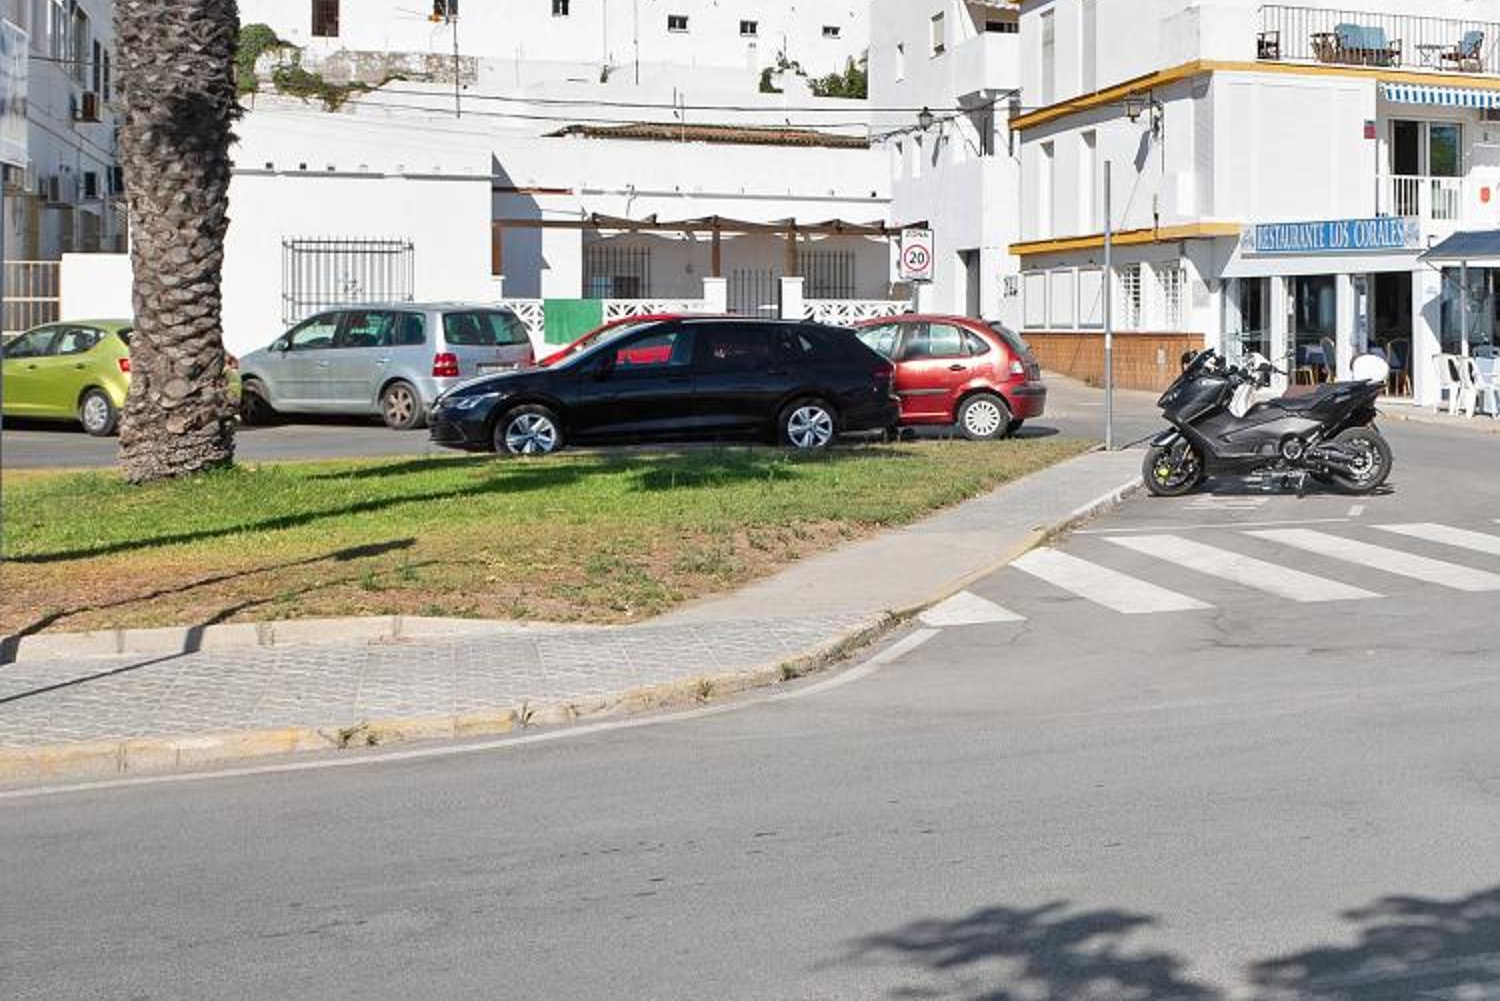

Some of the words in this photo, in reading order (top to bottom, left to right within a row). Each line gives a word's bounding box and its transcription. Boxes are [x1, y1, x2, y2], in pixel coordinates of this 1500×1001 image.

[1257, 223, 1325, 251] RESTAURANTE
[1329, 221, 1349, 249] LOS
[1353, 218, 1405, 248] CORALES
[909, 250, 925, 264] 20
